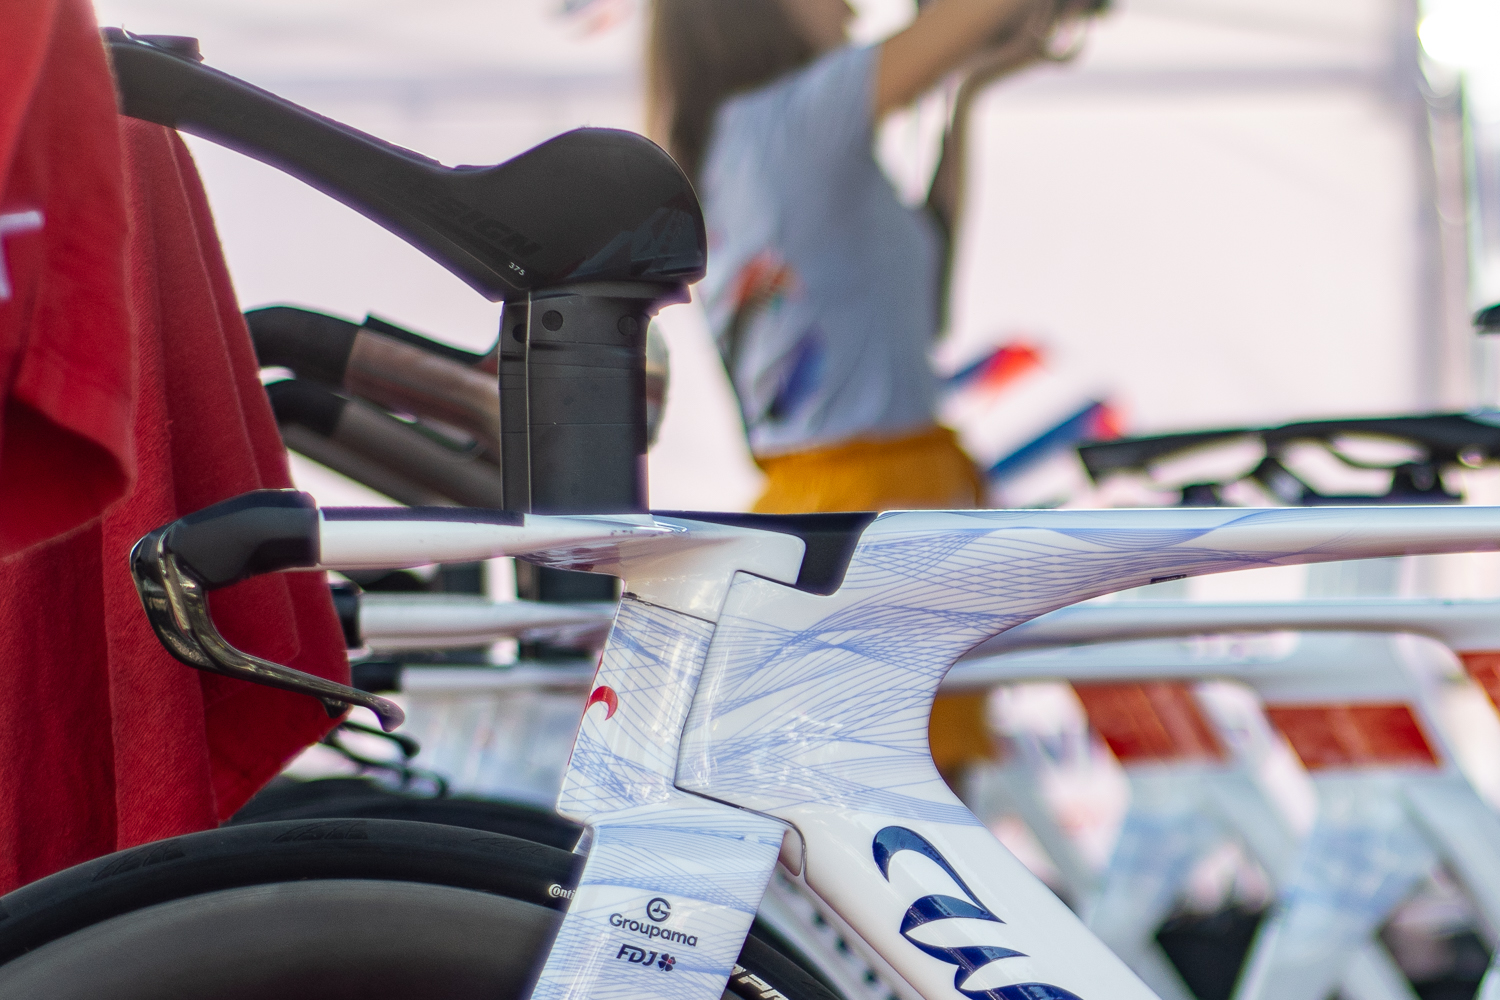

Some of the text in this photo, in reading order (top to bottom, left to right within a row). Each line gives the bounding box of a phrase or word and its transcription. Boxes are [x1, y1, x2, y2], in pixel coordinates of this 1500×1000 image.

[508, 261, 526, 277] 375
[609, 912, 699, 947] Groupama
[616, 943, 659, 967] FDJ
